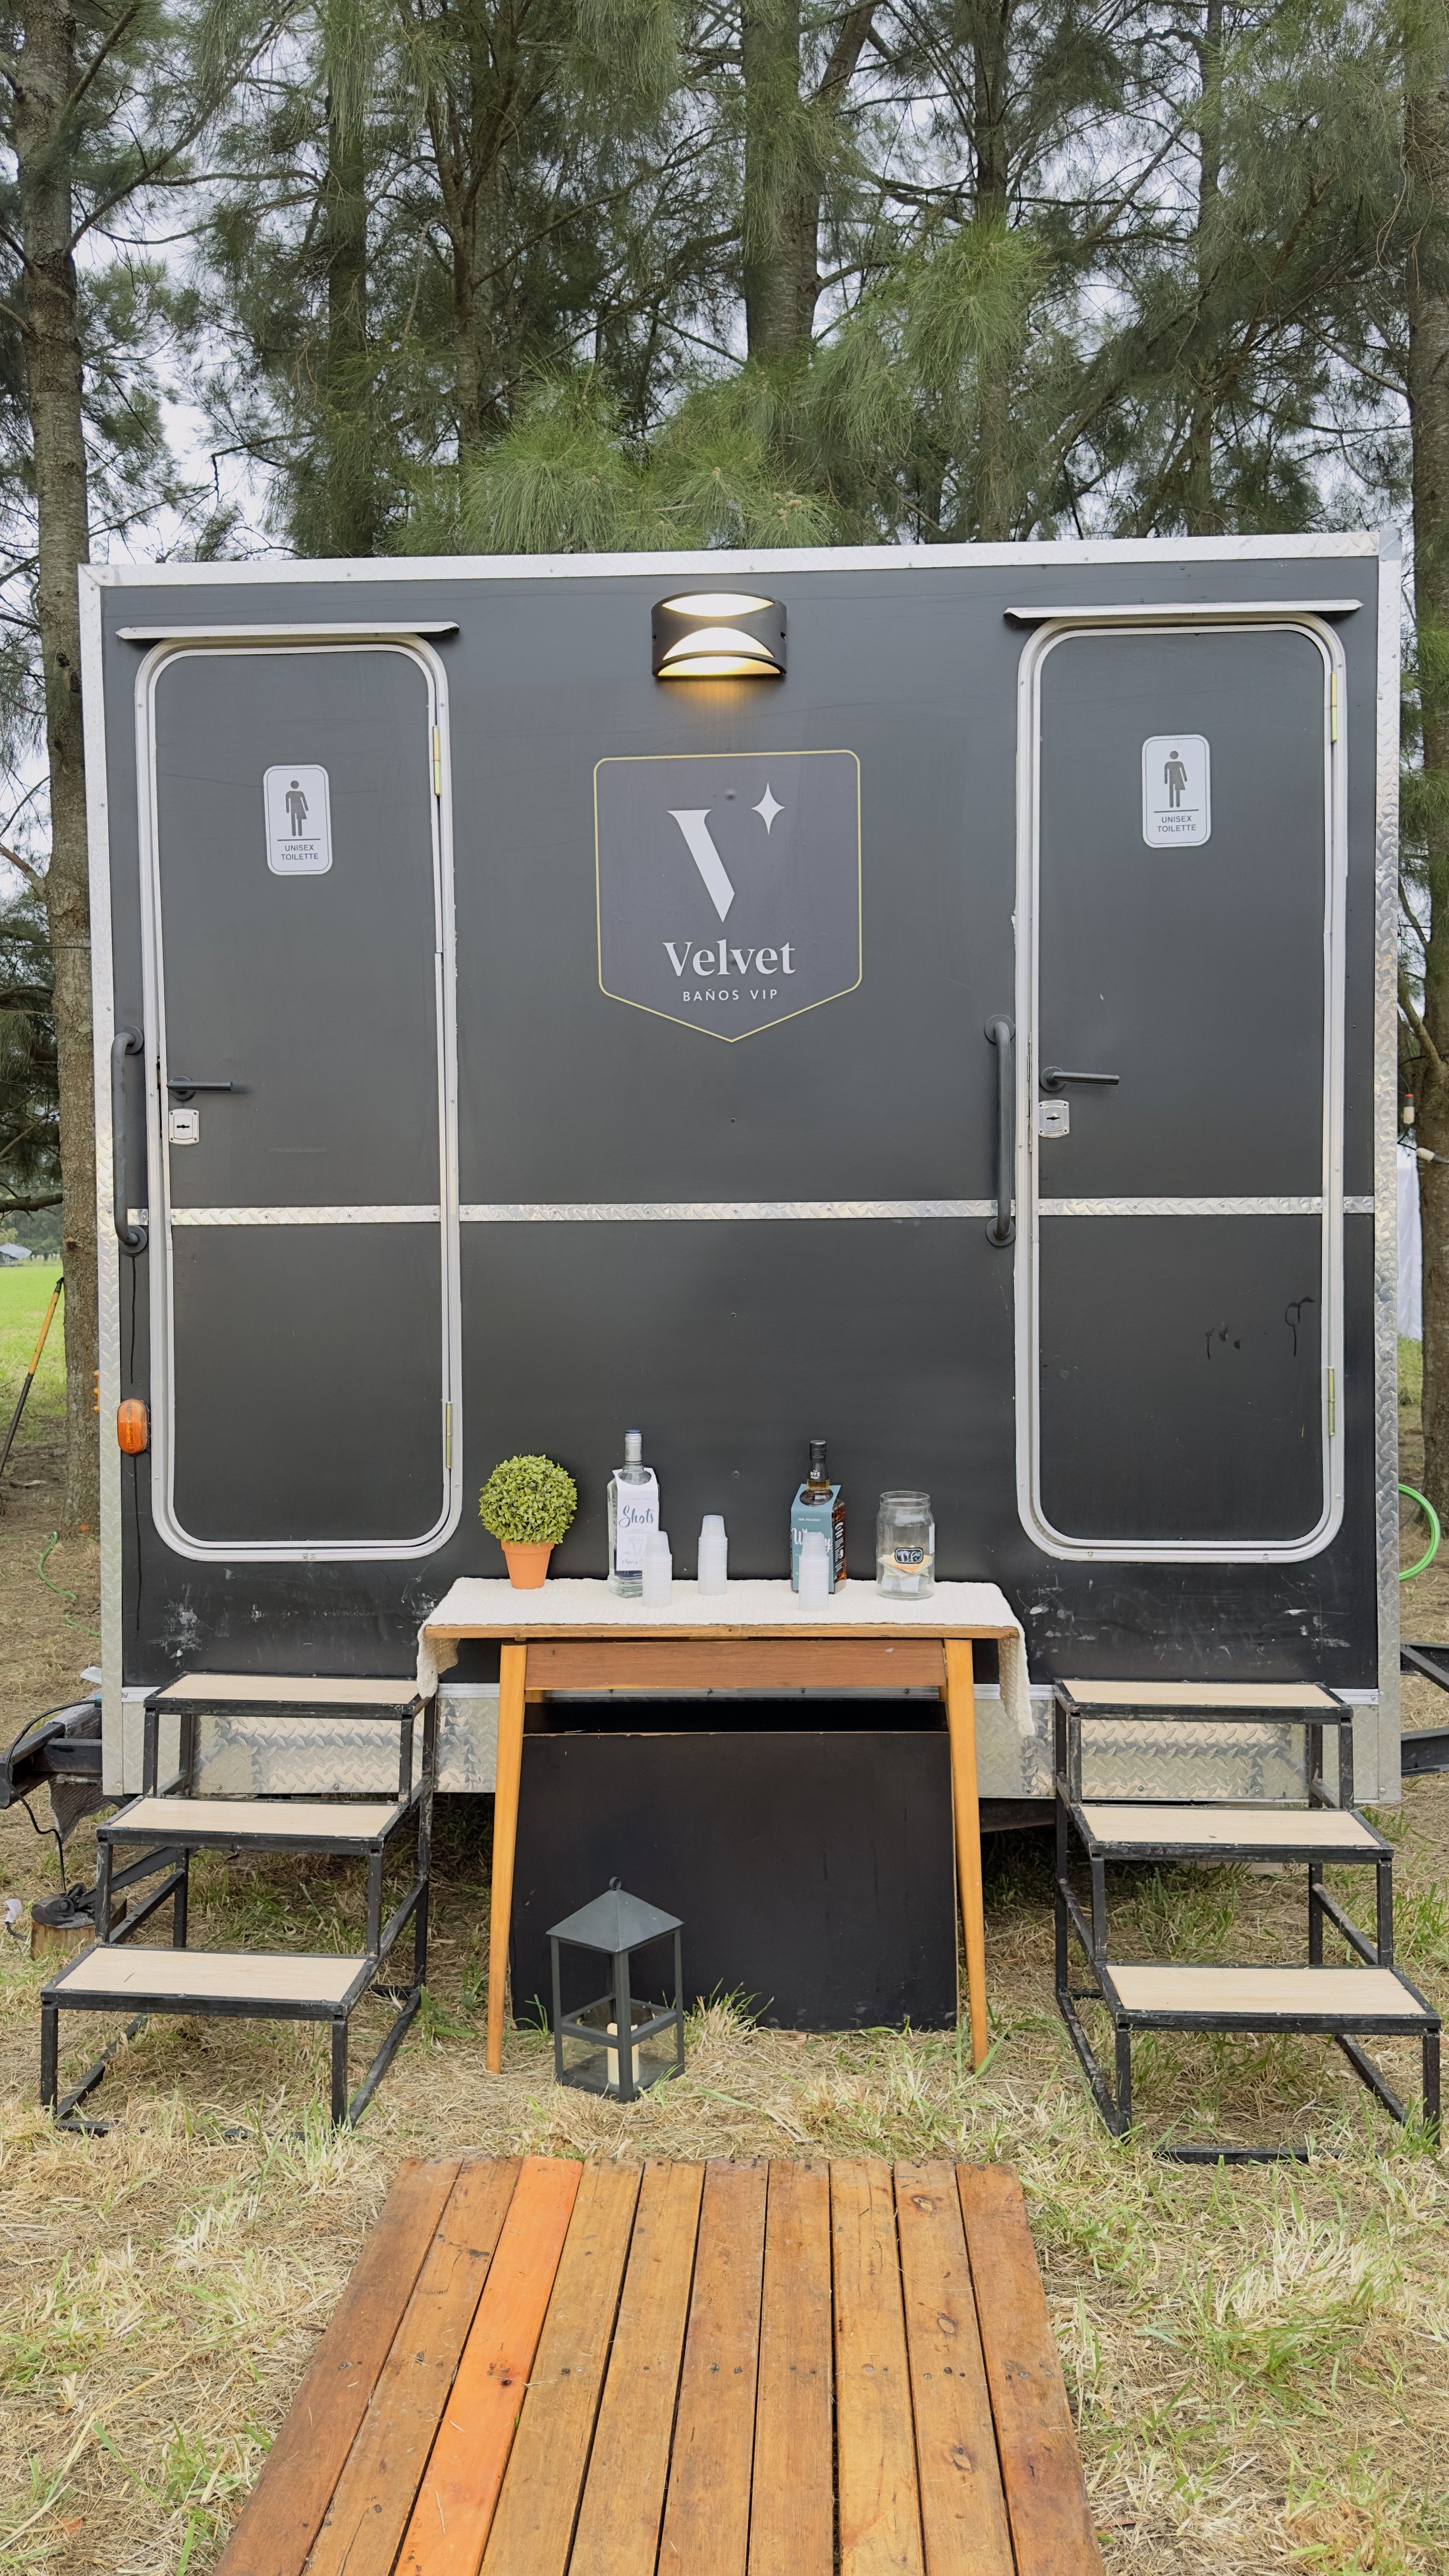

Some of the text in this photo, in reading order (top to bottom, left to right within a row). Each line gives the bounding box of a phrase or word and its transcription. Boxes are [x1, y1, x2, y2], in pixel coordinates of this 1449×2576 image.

[1157, 824, 1197, 833] TOILETTE
[663, 939, 796, 977] Velvet
[683, 989, 778, 1002] BAÑOS VIP
[618, 1504, 654, 1528] Shots
